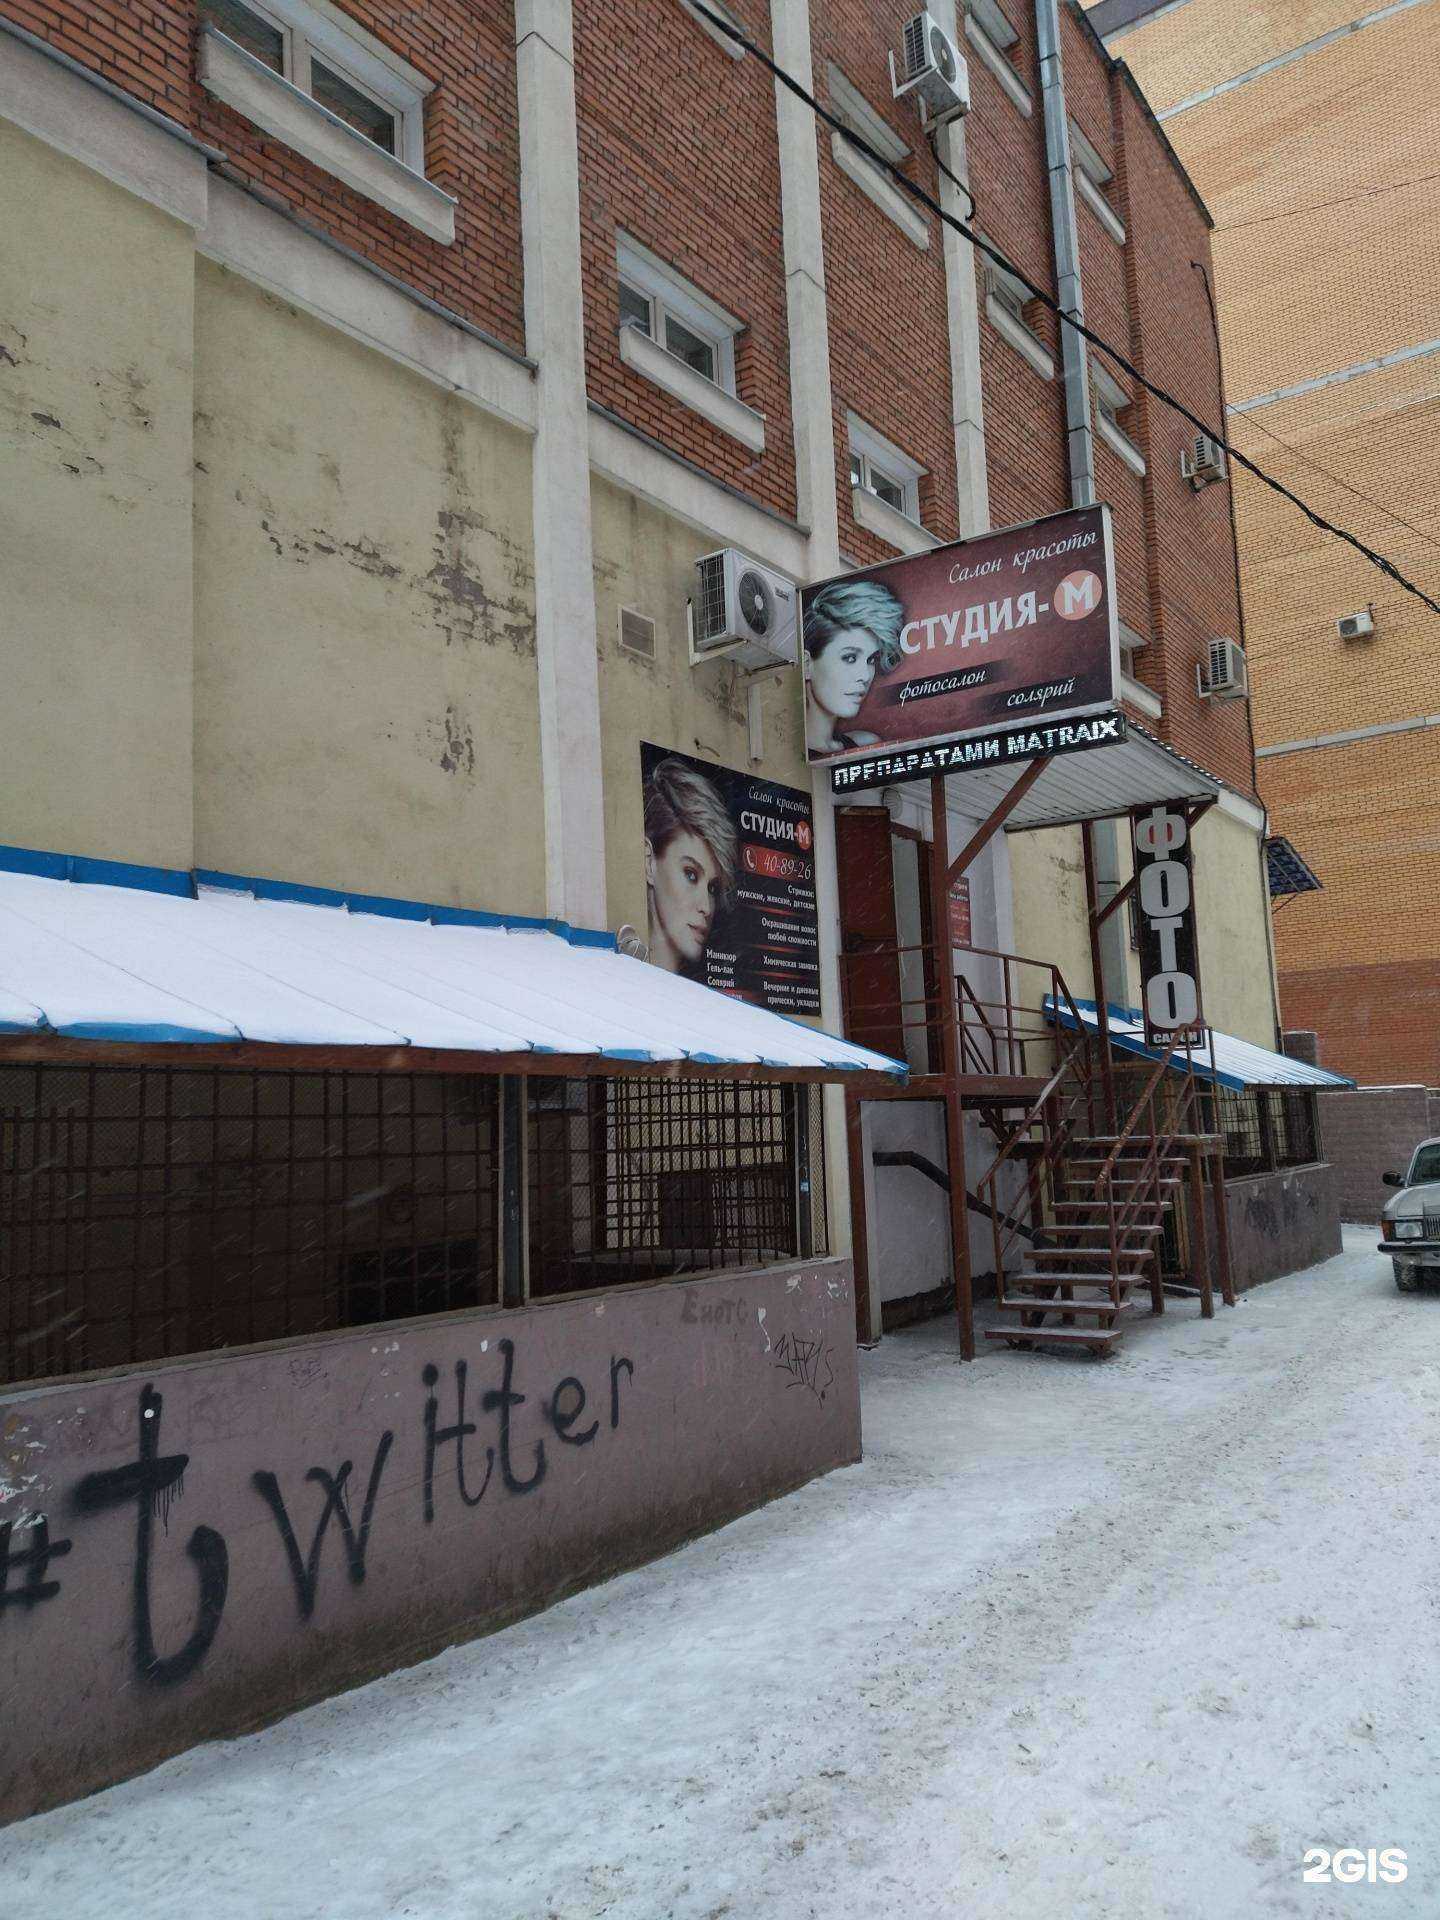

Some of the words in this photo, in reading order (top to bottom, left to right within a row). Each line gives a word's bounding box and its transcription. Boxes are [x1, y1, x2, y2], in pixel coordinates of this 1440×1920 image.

[948, 557, 1003, 585] Салон
[1013, 530, 1099, 574] красоты
[899, 670, 987, 707] фотосалон
[1006, 676, 1076, 708] солярий
[747, 785, 773, 804] Салон
[776, 797, 811, 815] красоты
[763, 853, 812, 880] 40-89-26
[1135, 806, 1199, 1029] ФОТО
[767, 932, 787, 943] любой
[706, 948, 737, 963] Маникюр
[707, 962, 734, 975] Гель-лак
[707, 975, 735, 989] Солярий
